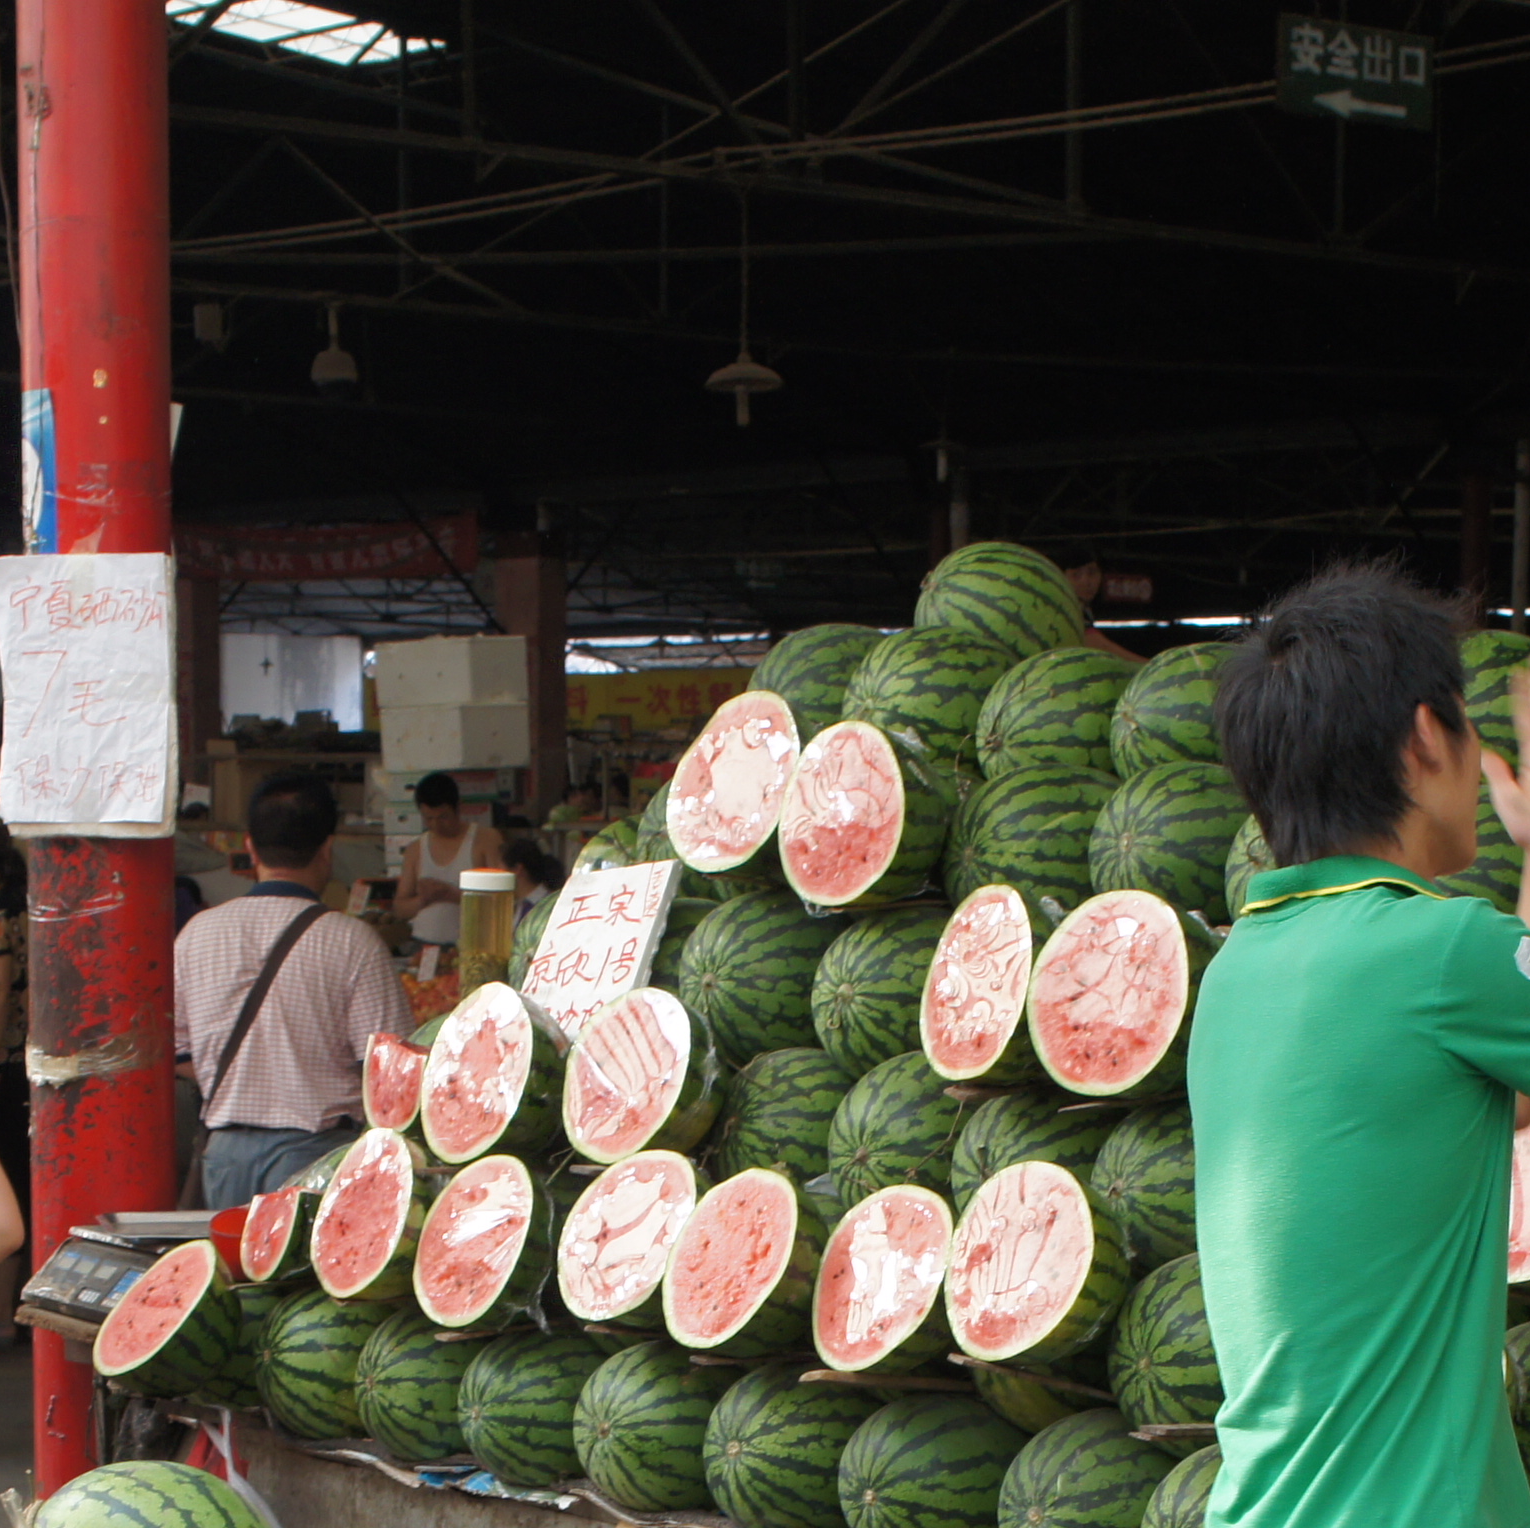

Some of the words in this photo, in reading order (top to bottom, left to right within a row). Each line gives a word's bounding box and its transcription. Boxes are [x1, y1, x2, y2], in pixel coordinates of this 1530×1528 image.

[1288, 24, 1426, 86] 安全出口
[21, 649, 128, 739] 7毛
[556, 884, 642, 930] 正宗
[523, 936, 638, 994] 京欣1号
